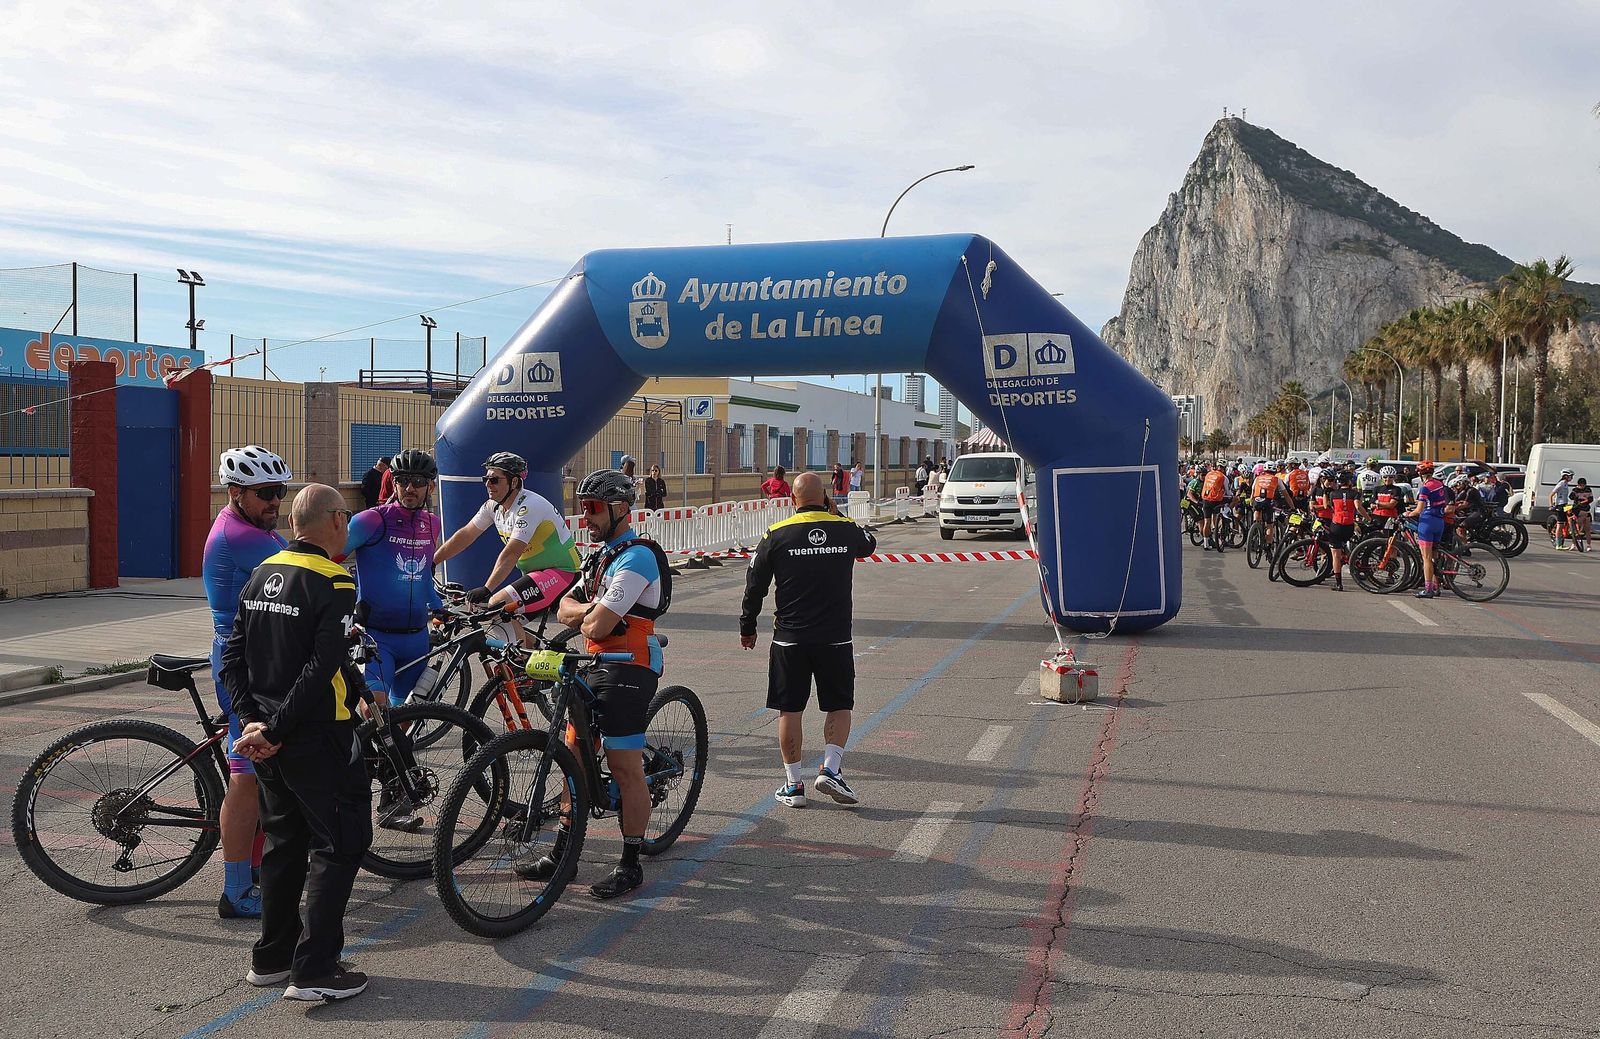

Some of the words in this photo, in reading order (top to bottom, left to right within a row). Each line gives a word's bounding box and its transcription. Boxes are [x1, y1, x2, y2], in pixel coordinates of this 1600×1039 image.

[677, 270, 907, 311] Ayuntamiento
[705, 313, 742, 340] de
[751, 312, 787, 339] La
[795, 309, 883, 337] Línea
[987, 377, 1044, 389] DELEGACIÓN
[1046, 377, 1059, 385] DE
[487, 394, 535, 403] DELEGACIÓN
[537, 394, 549, 402] DE
[989, 389, 1077, 406] DEPORTES
[486, 405, 566, 420] DEPORTES
[535, 662, 550, 670] 098
